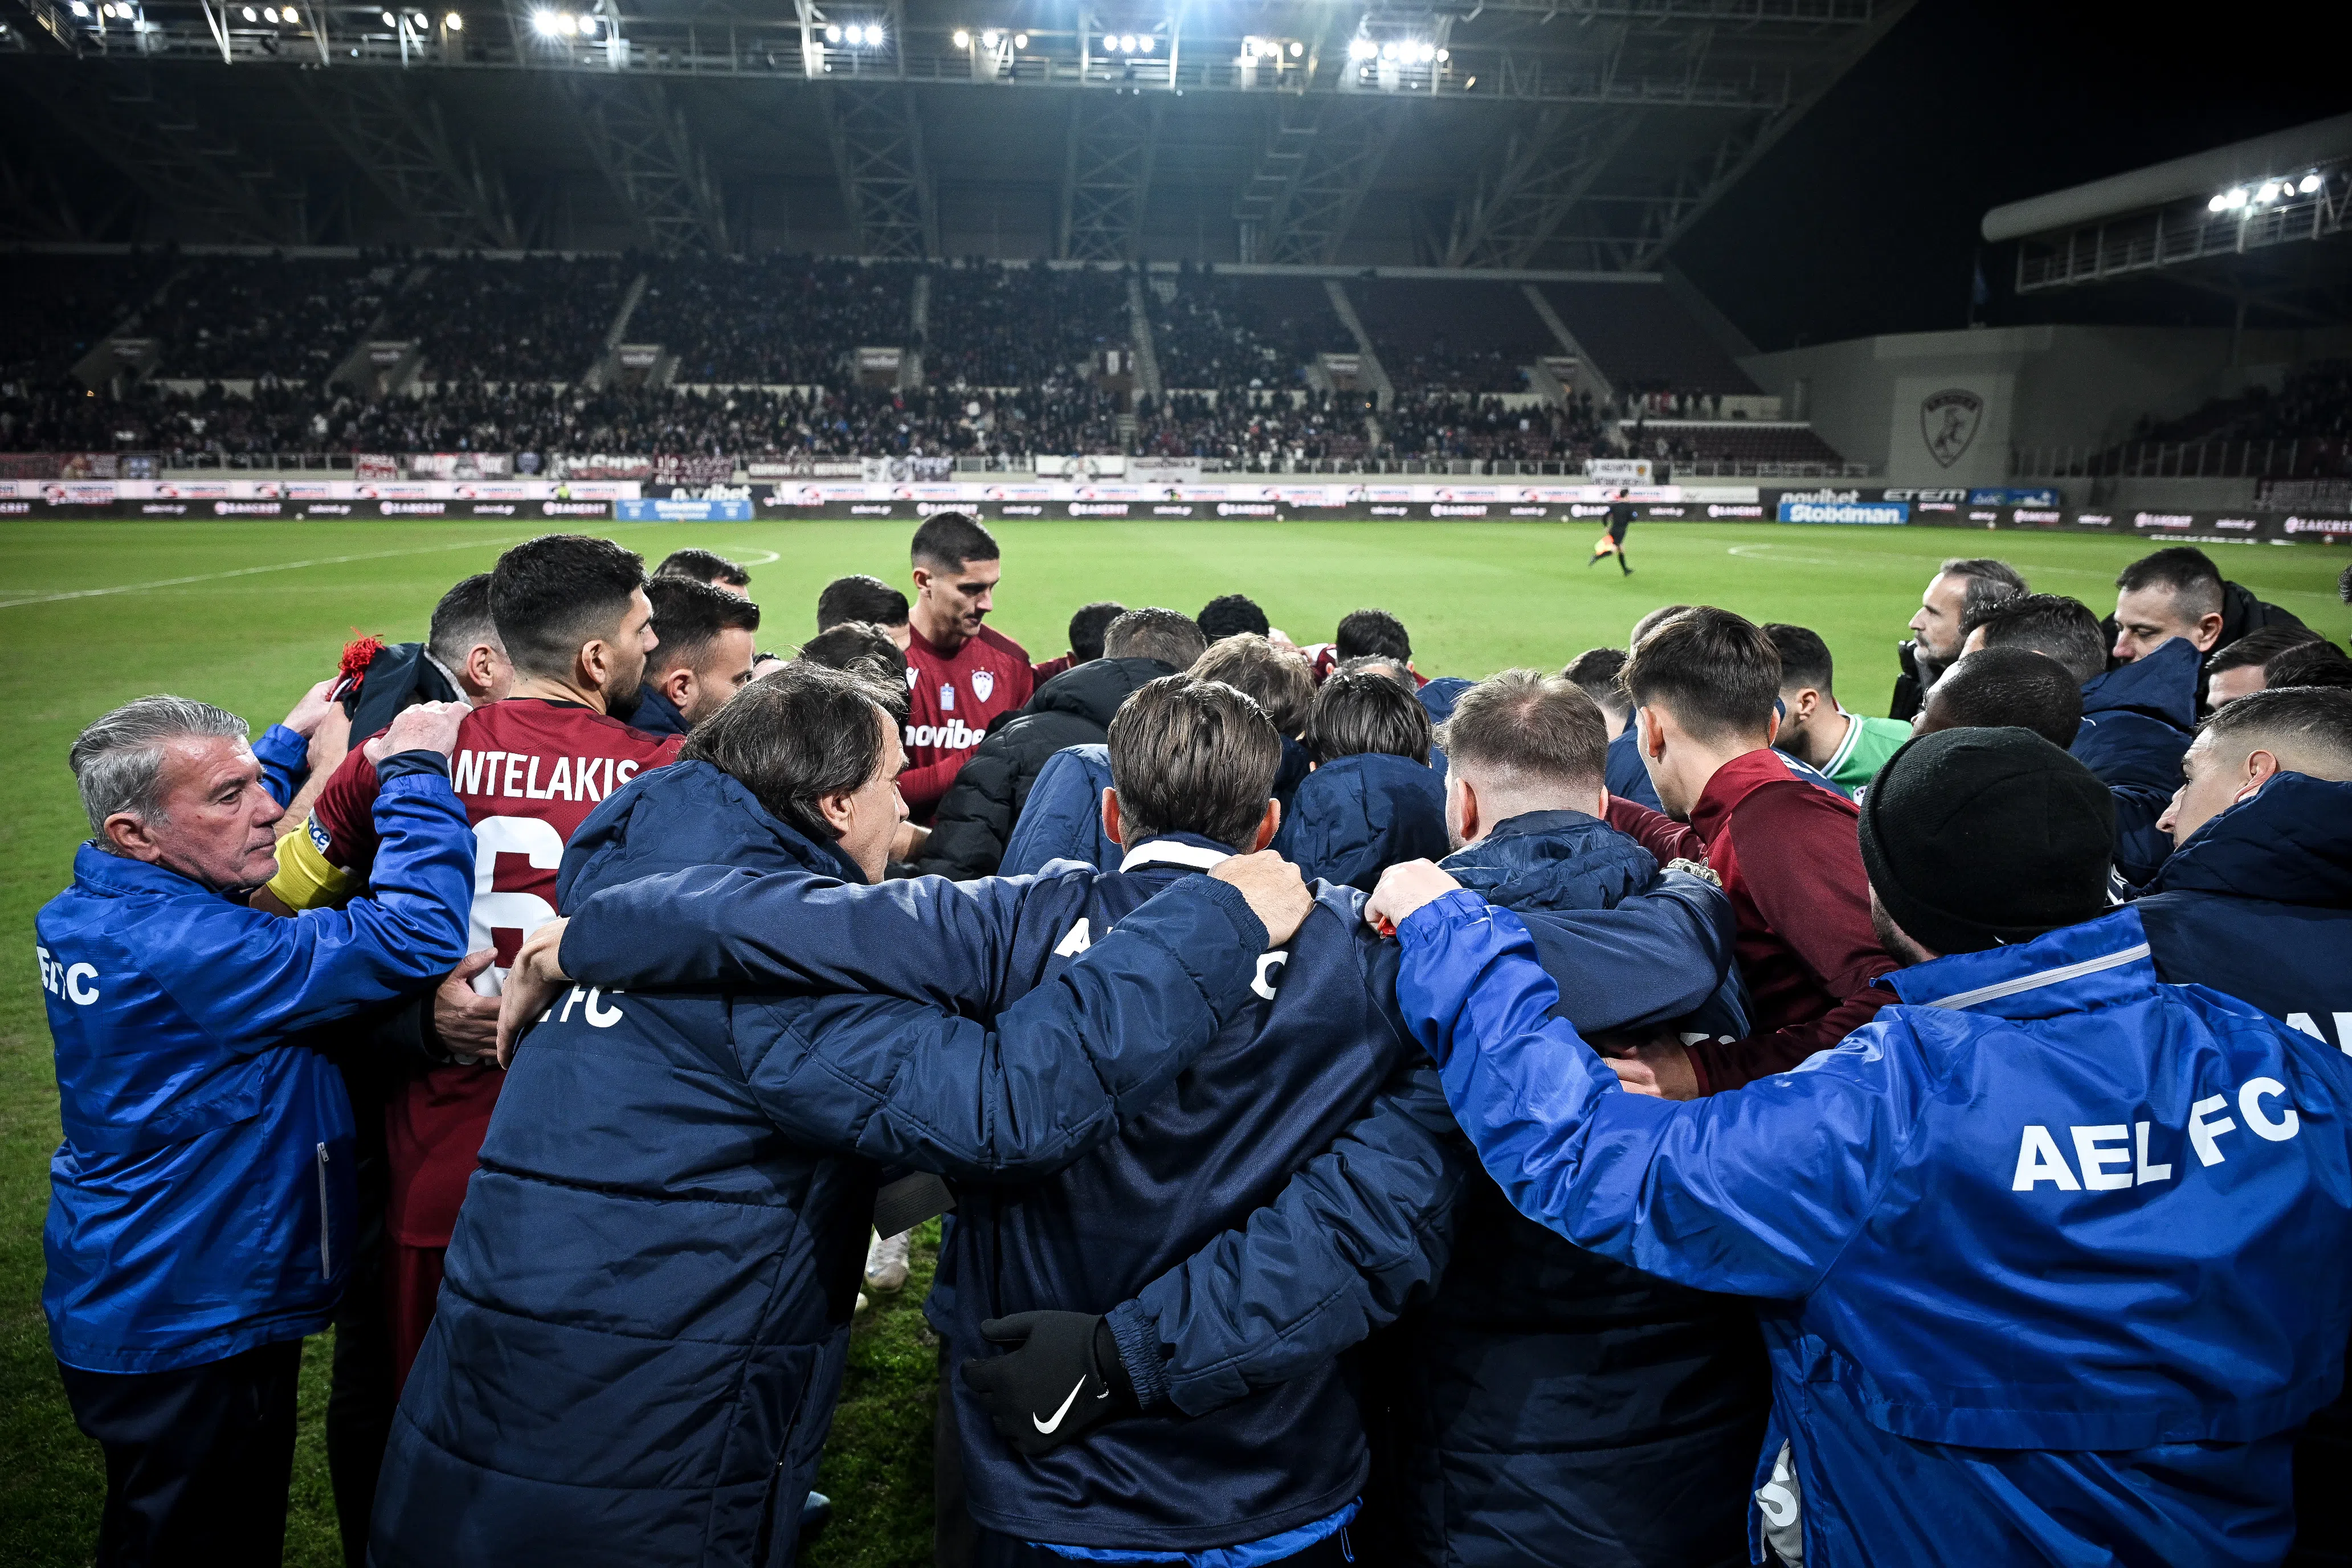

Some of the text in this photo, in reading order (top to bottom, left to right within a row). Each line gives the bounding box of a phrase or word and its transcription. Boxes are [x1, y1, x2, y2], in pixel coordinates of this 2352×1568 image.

[905, 718, 986, 749] novibe
[448, 749, 639, 802] NTELAKIS
[464, 815, 565, 998] 6
[2012, 1077, 2300, 1191] AEL FC
